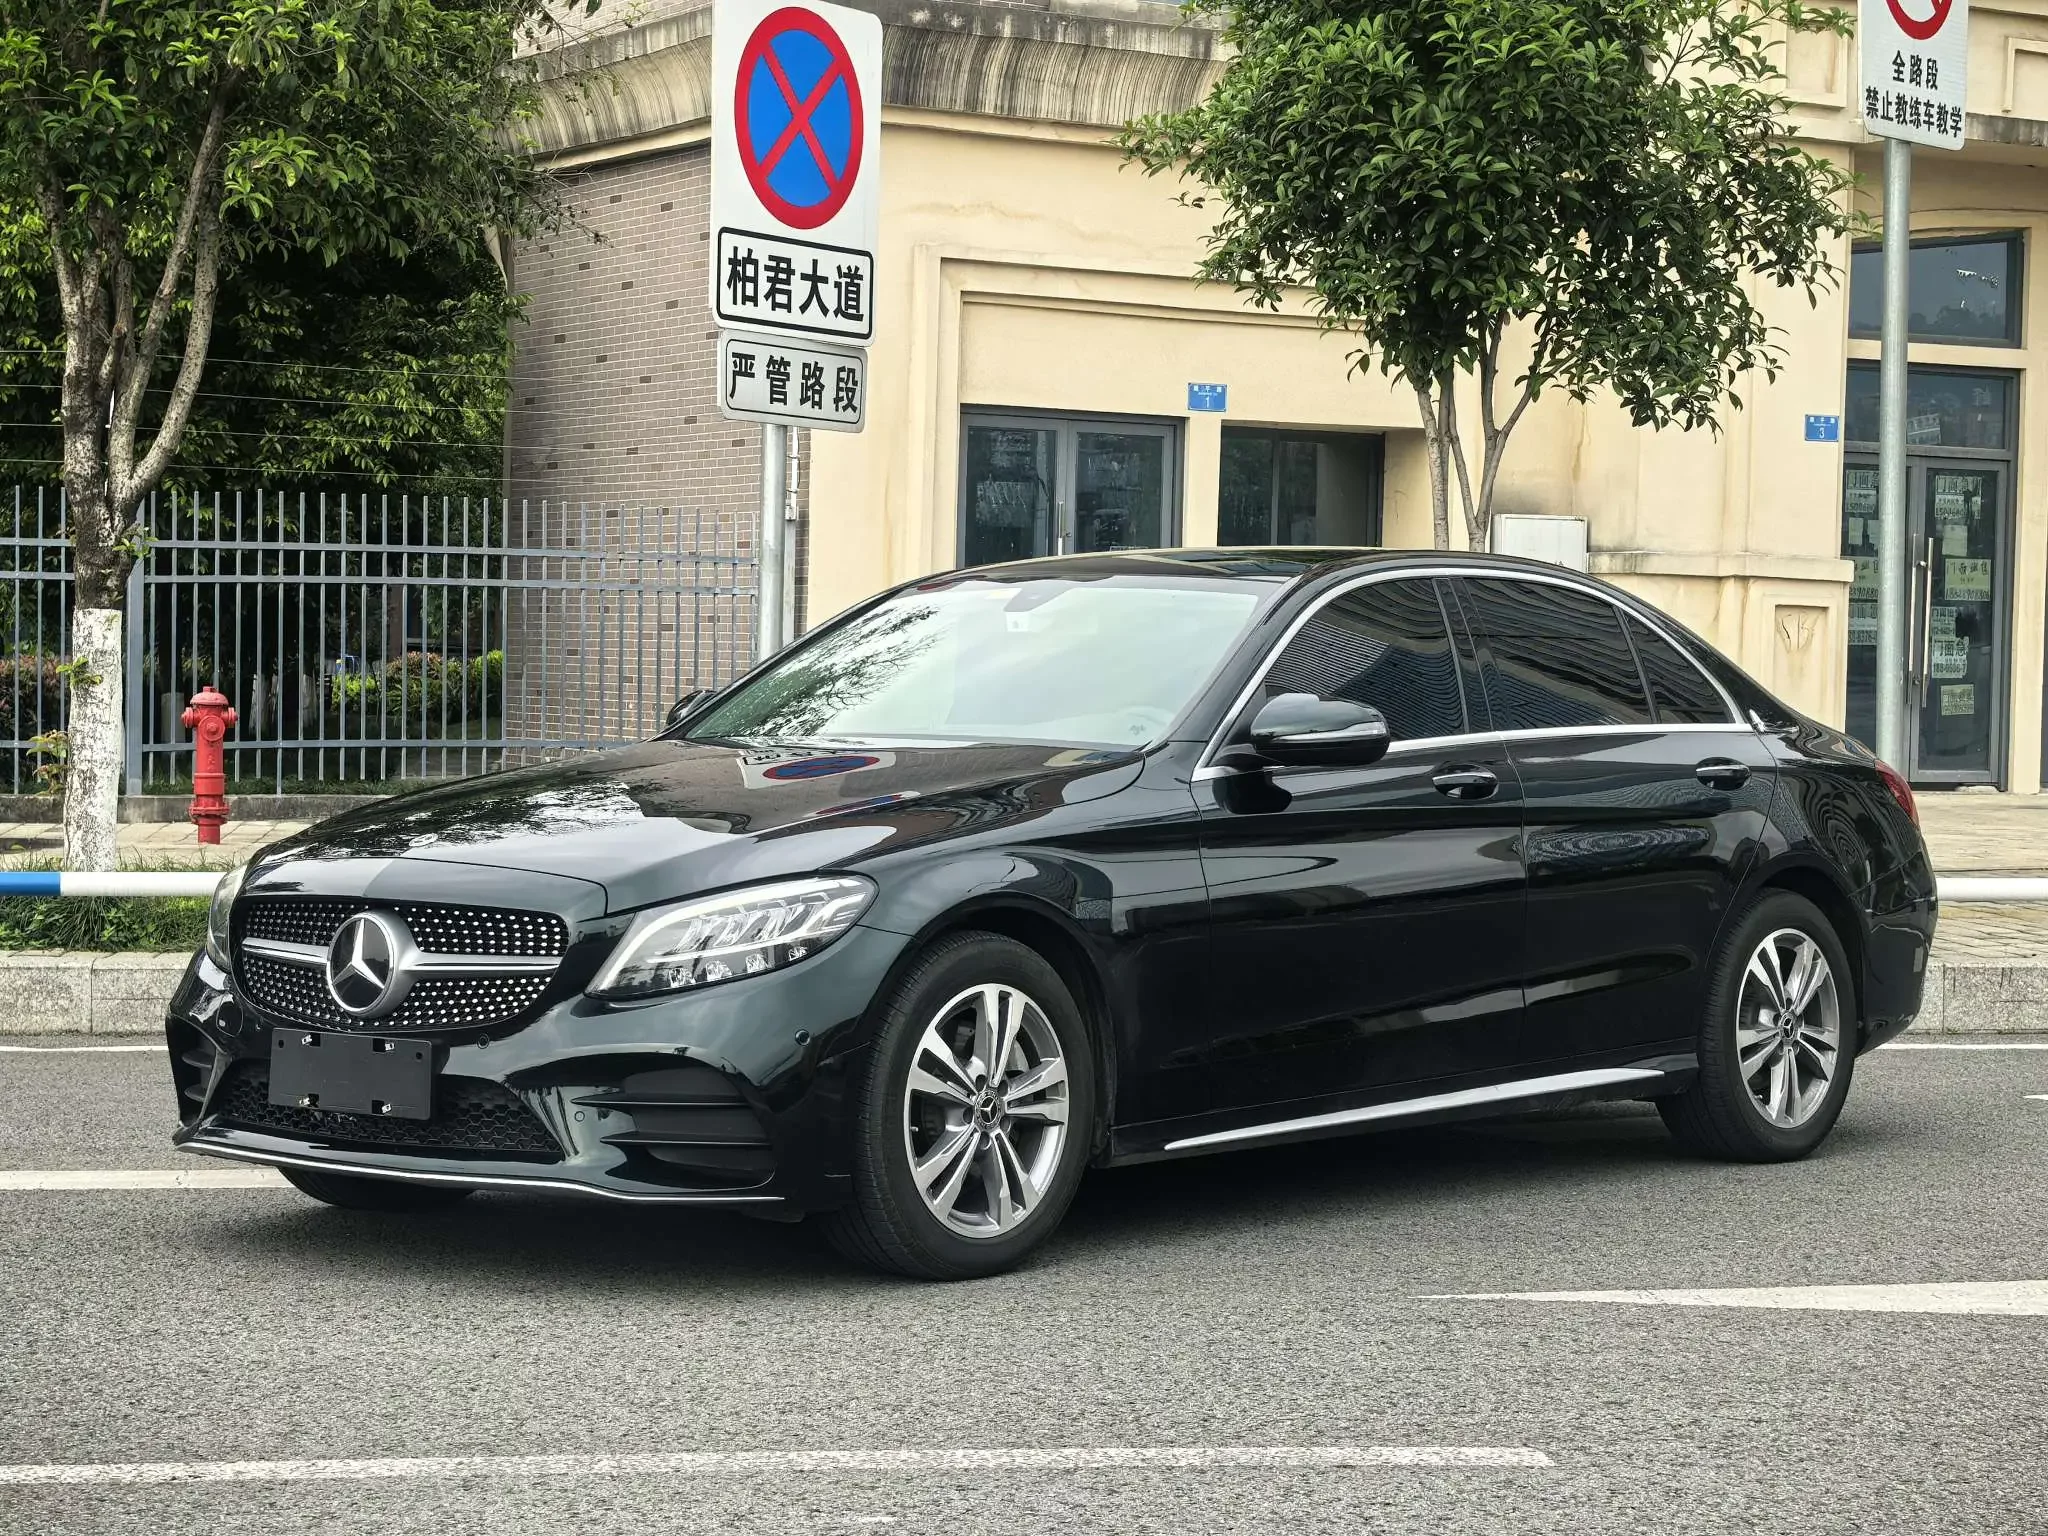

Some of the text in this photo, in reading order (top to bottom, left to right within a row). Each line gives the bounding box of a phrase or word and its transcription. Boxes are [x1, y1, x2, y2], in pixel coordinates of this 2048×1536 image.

[1892, 50, 1938, 90] 全路段
[1865, 86, 1962, 138] 禁止教练车教学
[727, 246, 864, 322] 柏君大道
[729, 352, 858, 413] 严管路段
